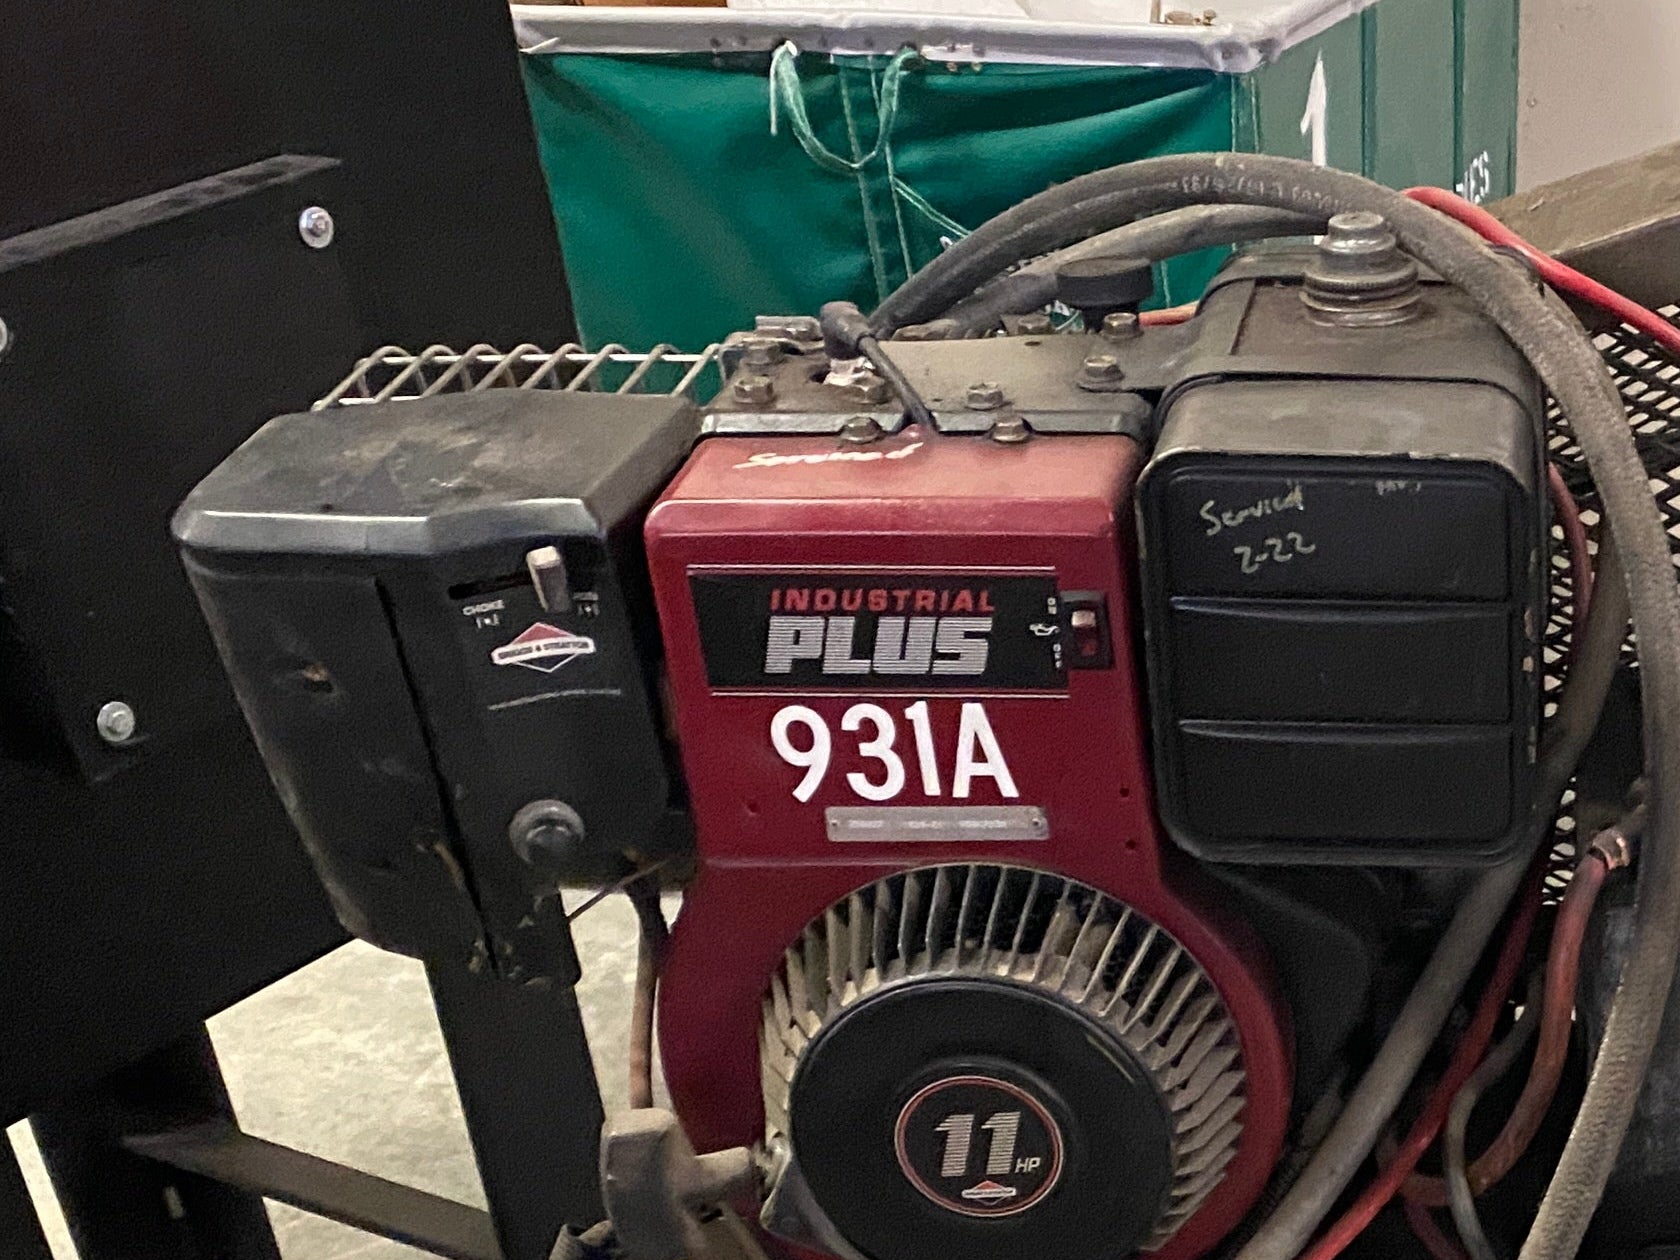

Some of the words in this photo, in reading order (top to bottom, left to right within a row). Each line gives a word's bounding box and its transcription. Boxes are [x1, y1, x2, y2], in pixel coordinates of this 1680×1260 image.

[771, 589, 994, 611] INDUSTRIAL
[764, 616, 993, 675] PLUS
[770, 701, 1019, 802] 931A
[934, 1111, 1021, 1178] 11
[1014, 1157, 1041, 1174] HP
